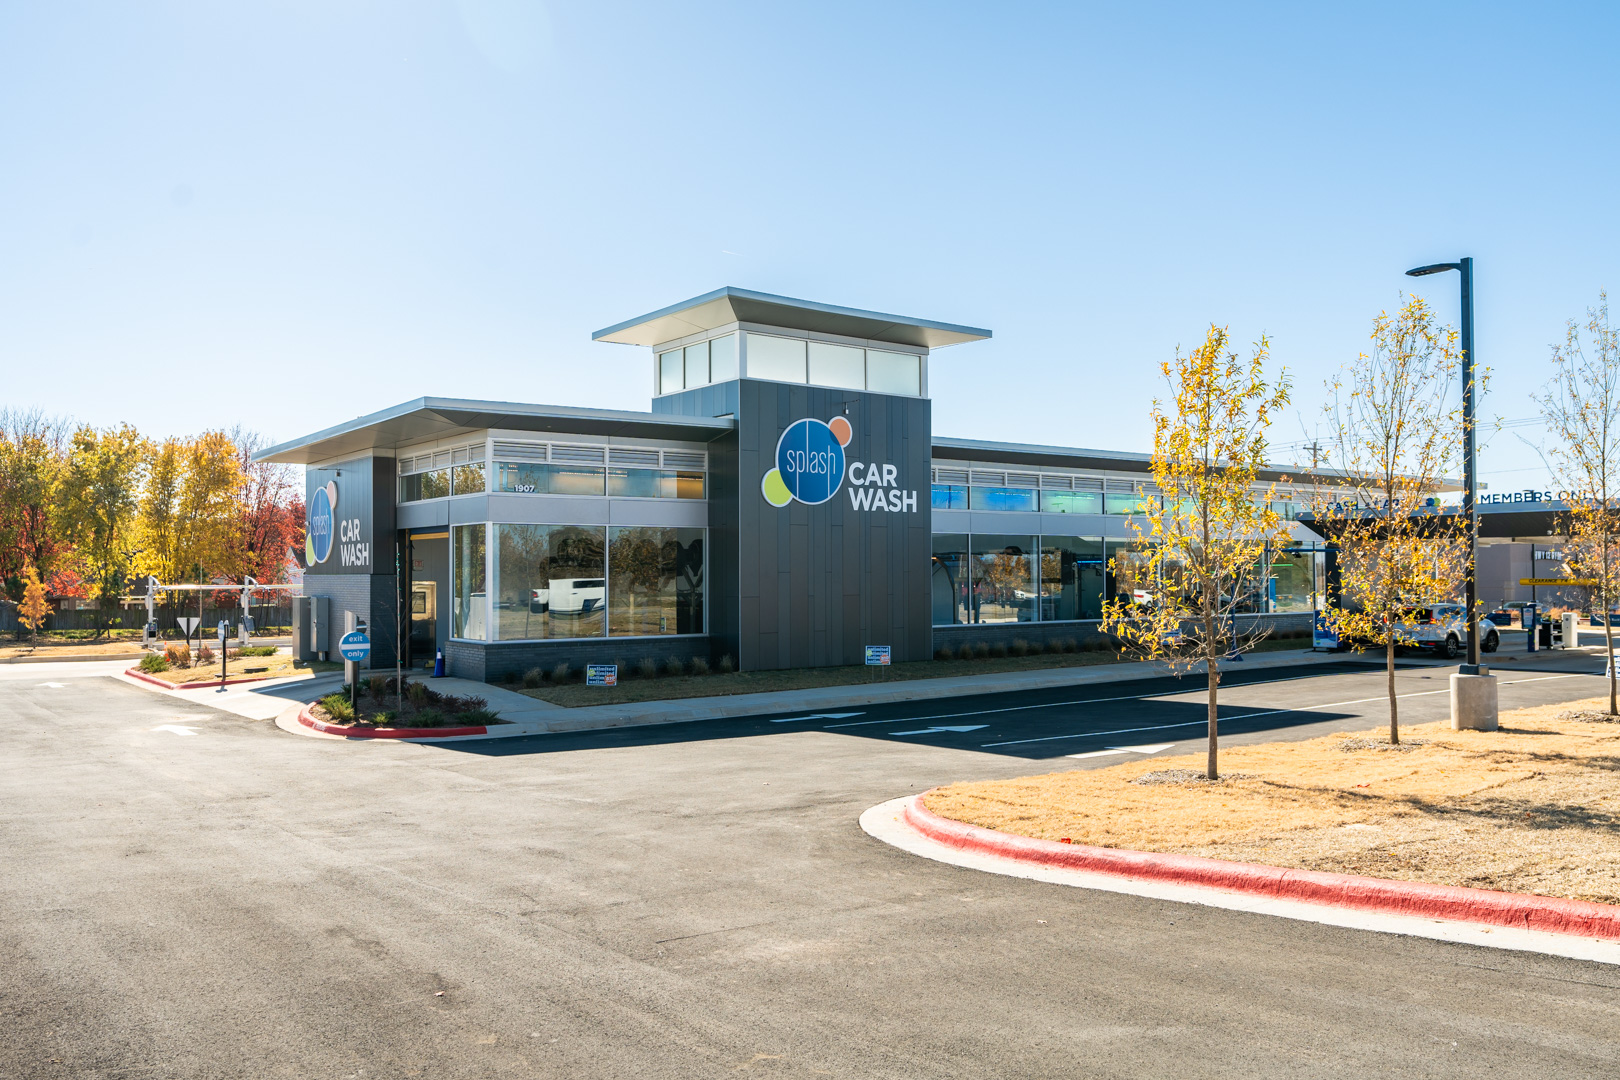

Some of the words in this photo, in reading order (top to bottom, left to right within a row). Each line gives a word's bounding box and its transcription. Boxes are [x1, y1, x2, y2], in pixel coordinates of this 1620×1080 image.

[848, 461, 898, 488] CAR
[514, 484, 535, 493] 1907
[1480, 491, 1553, 504] MEMBERS
[848, 487, 918, 513] WASH
[340, 518, 361, 543] CAR
[340, 542, 370, 567] WASH
[348, 635, 363, 643] exit
[347, 650, 364, 659] only
